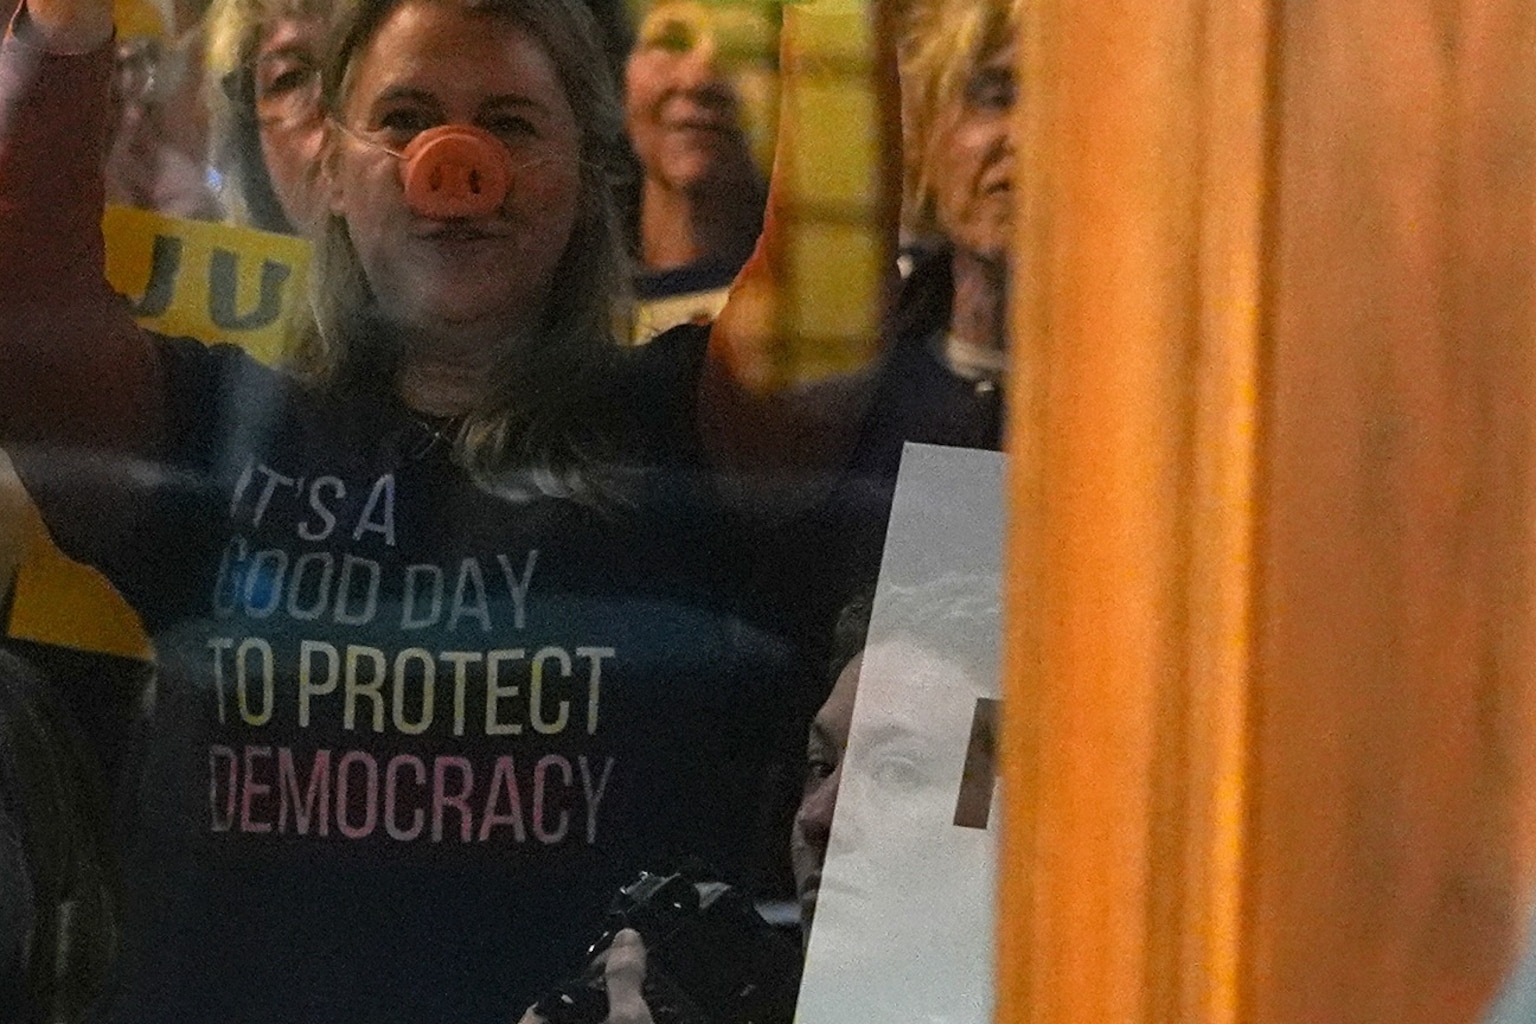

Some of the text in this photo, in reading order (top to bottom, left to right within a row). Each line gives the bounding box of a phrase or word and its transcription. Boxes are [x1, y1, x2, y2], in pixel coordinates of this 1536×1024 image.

[229, 465, 398, 547] IT'S A
[213, 536, 540, 634] GOOD DAY
[207, 636, 617, 737] TO PROTECT
[207, 743, 616, 846] DEMOCRACY
